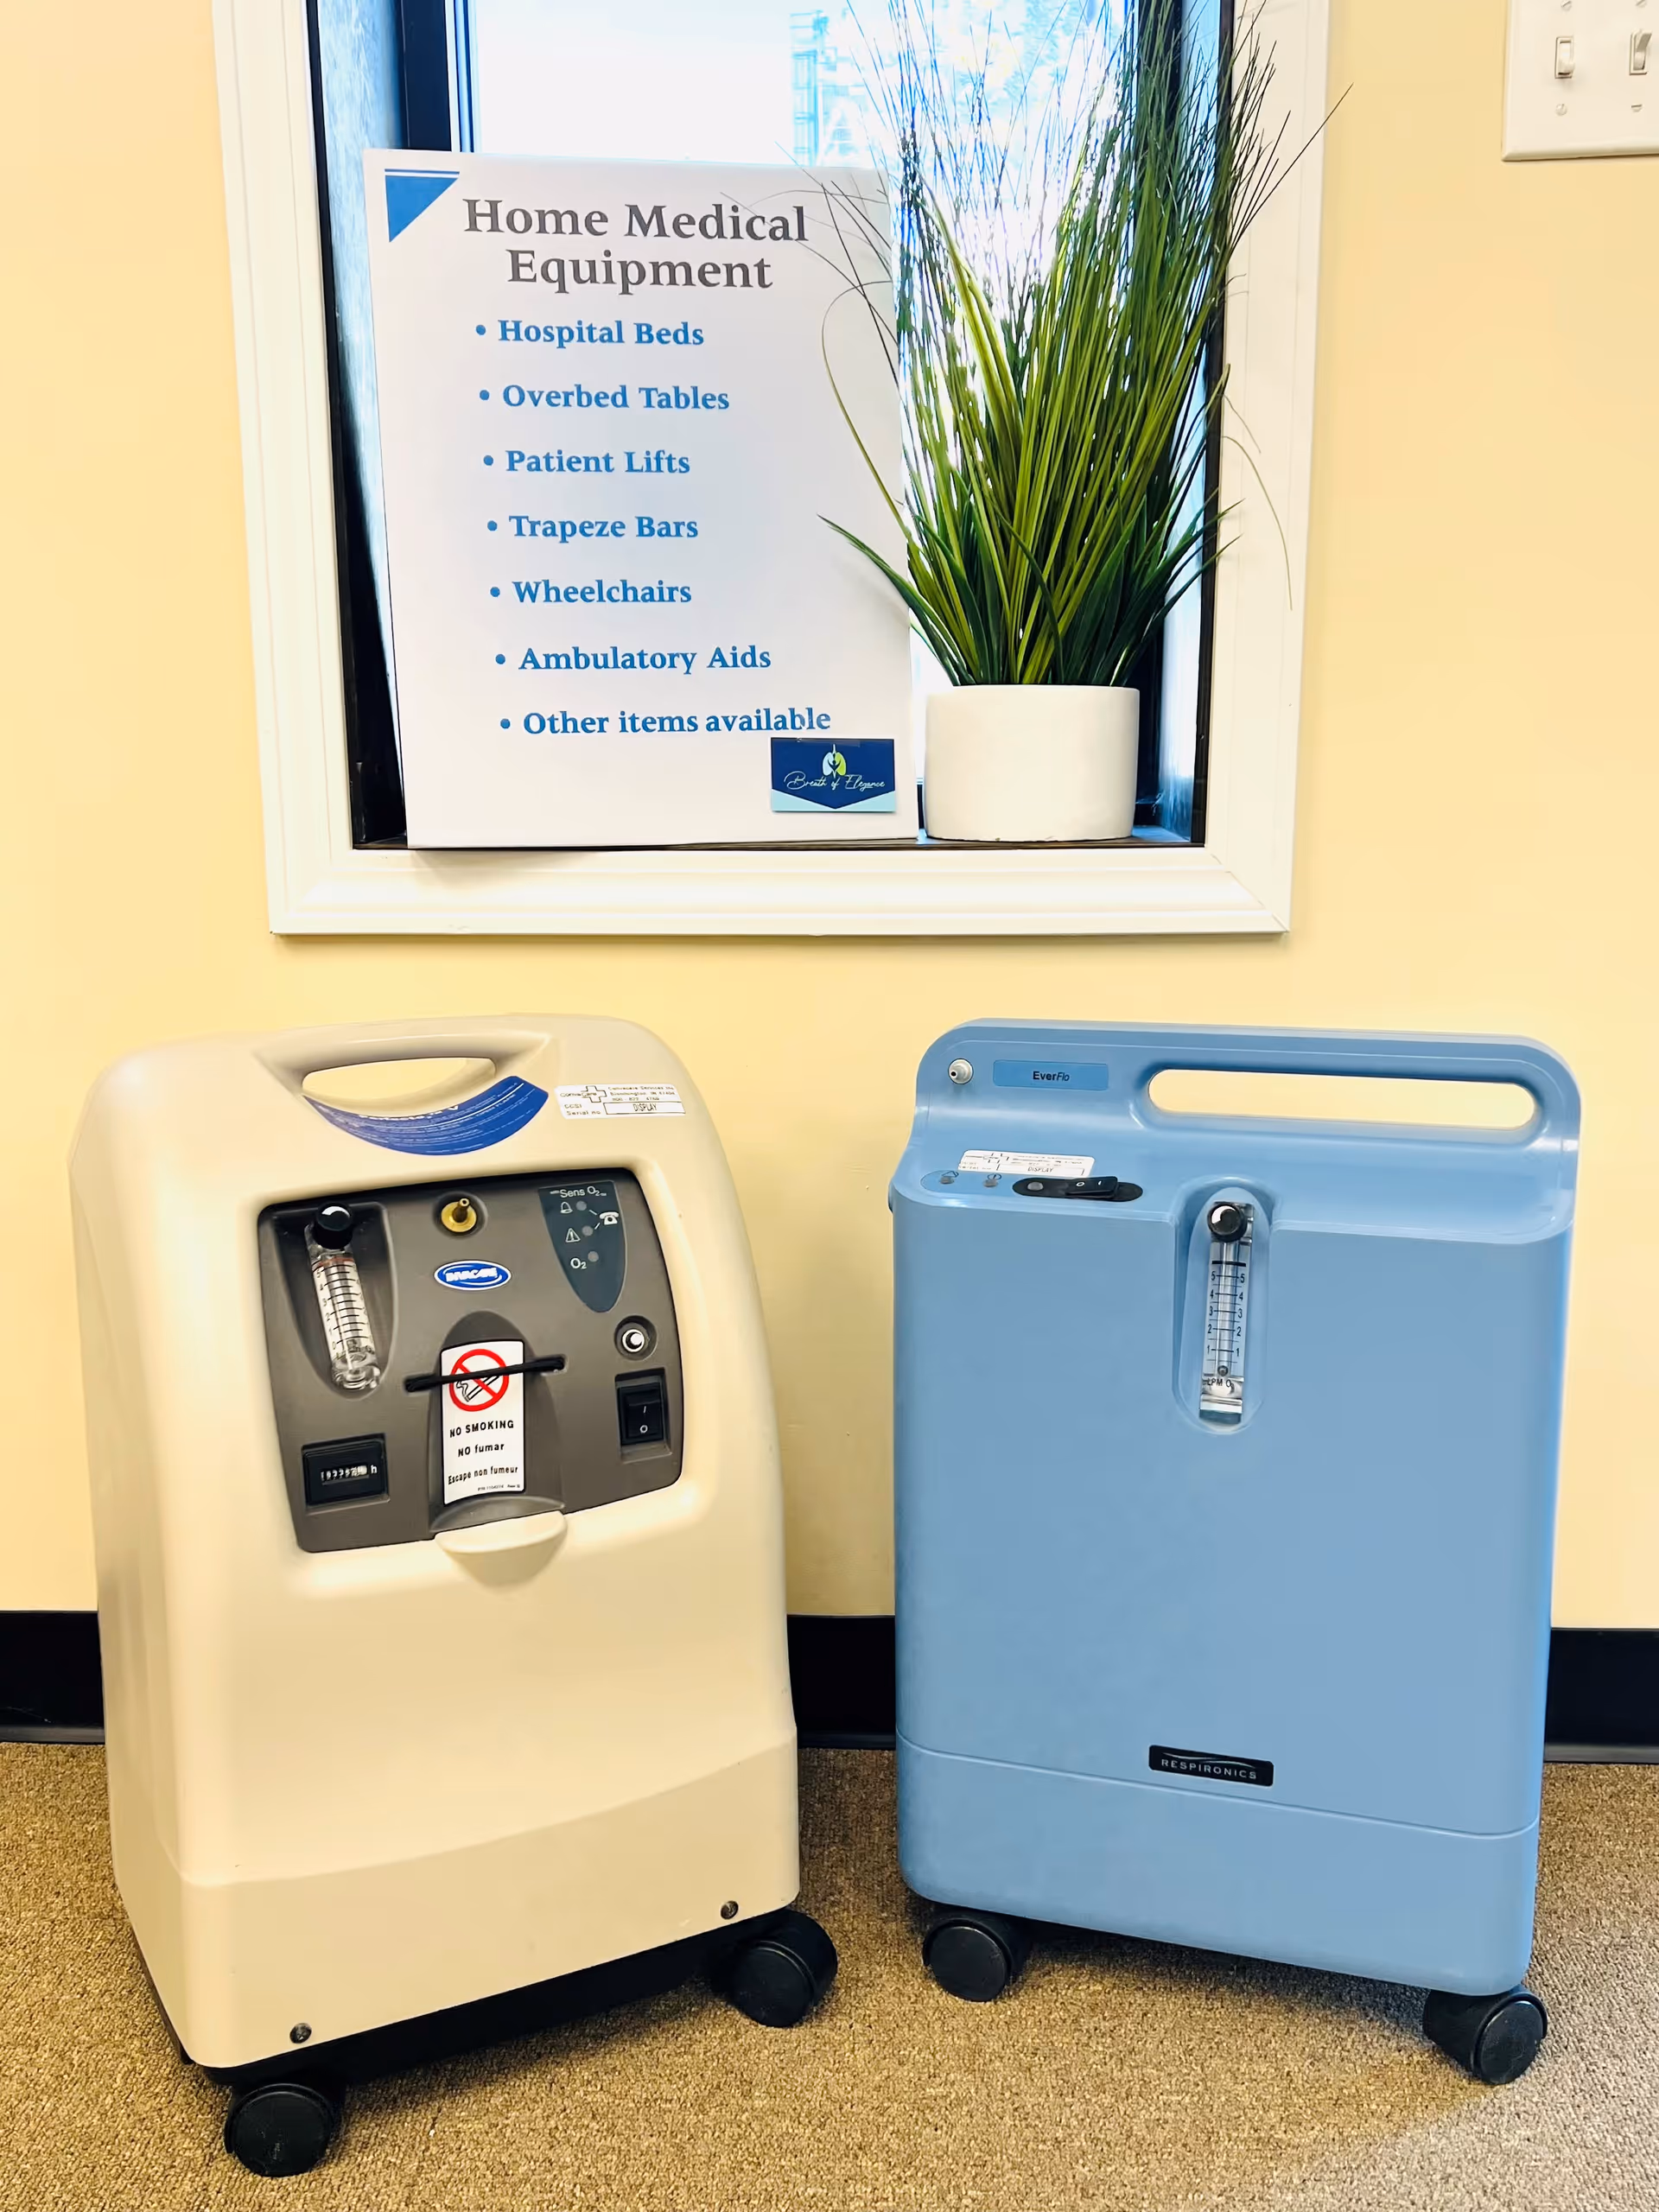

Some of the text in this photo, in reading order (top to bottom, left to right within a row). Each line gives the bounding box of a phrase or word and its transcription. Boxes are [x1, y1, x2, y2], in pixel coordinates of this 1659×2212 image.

[462, 199, 809, 242] Home Medical
[505, 249, 773, 296] Equipment
[498, 320, 705, 349] Hospital Beds
[502, 384, 730, 410] Overbed Tables
[505, 449, 690, 474] Patient Lifts
[508, 515, 698, 543] Trapeze Bars
[512, 579, 692, 603] Wheelchairs
[518, 645, 772, 675] Ambulatory Aids
[523, 707, 831, 734] Other items available
[784, 771, 886, 792] Breath of Elegance
[1033, 1071, 1071, 1082] EverFlo
[632, 1103, 658, 1112] DISPLAY
[559, 1189, 585, 1198] Sens
[1211, 1271, 1245, 1284] 5 5
[1210, 1290, 1244, 1302] 4 4
[1209, 1306, 1243, 1319] 3 3
[1207, 1324, 1242, 1337] 2 2
[1206, 1344, 1240, 1357] 1 1
[449, 1420, 514, 1439] NO SMOKING
[458, 1443, 505, 1458] NO fumar
[448, 1465, 518, 1485] Escape non fumeur
[1161, 1758, 1256, 1779] RESPIRONICS
